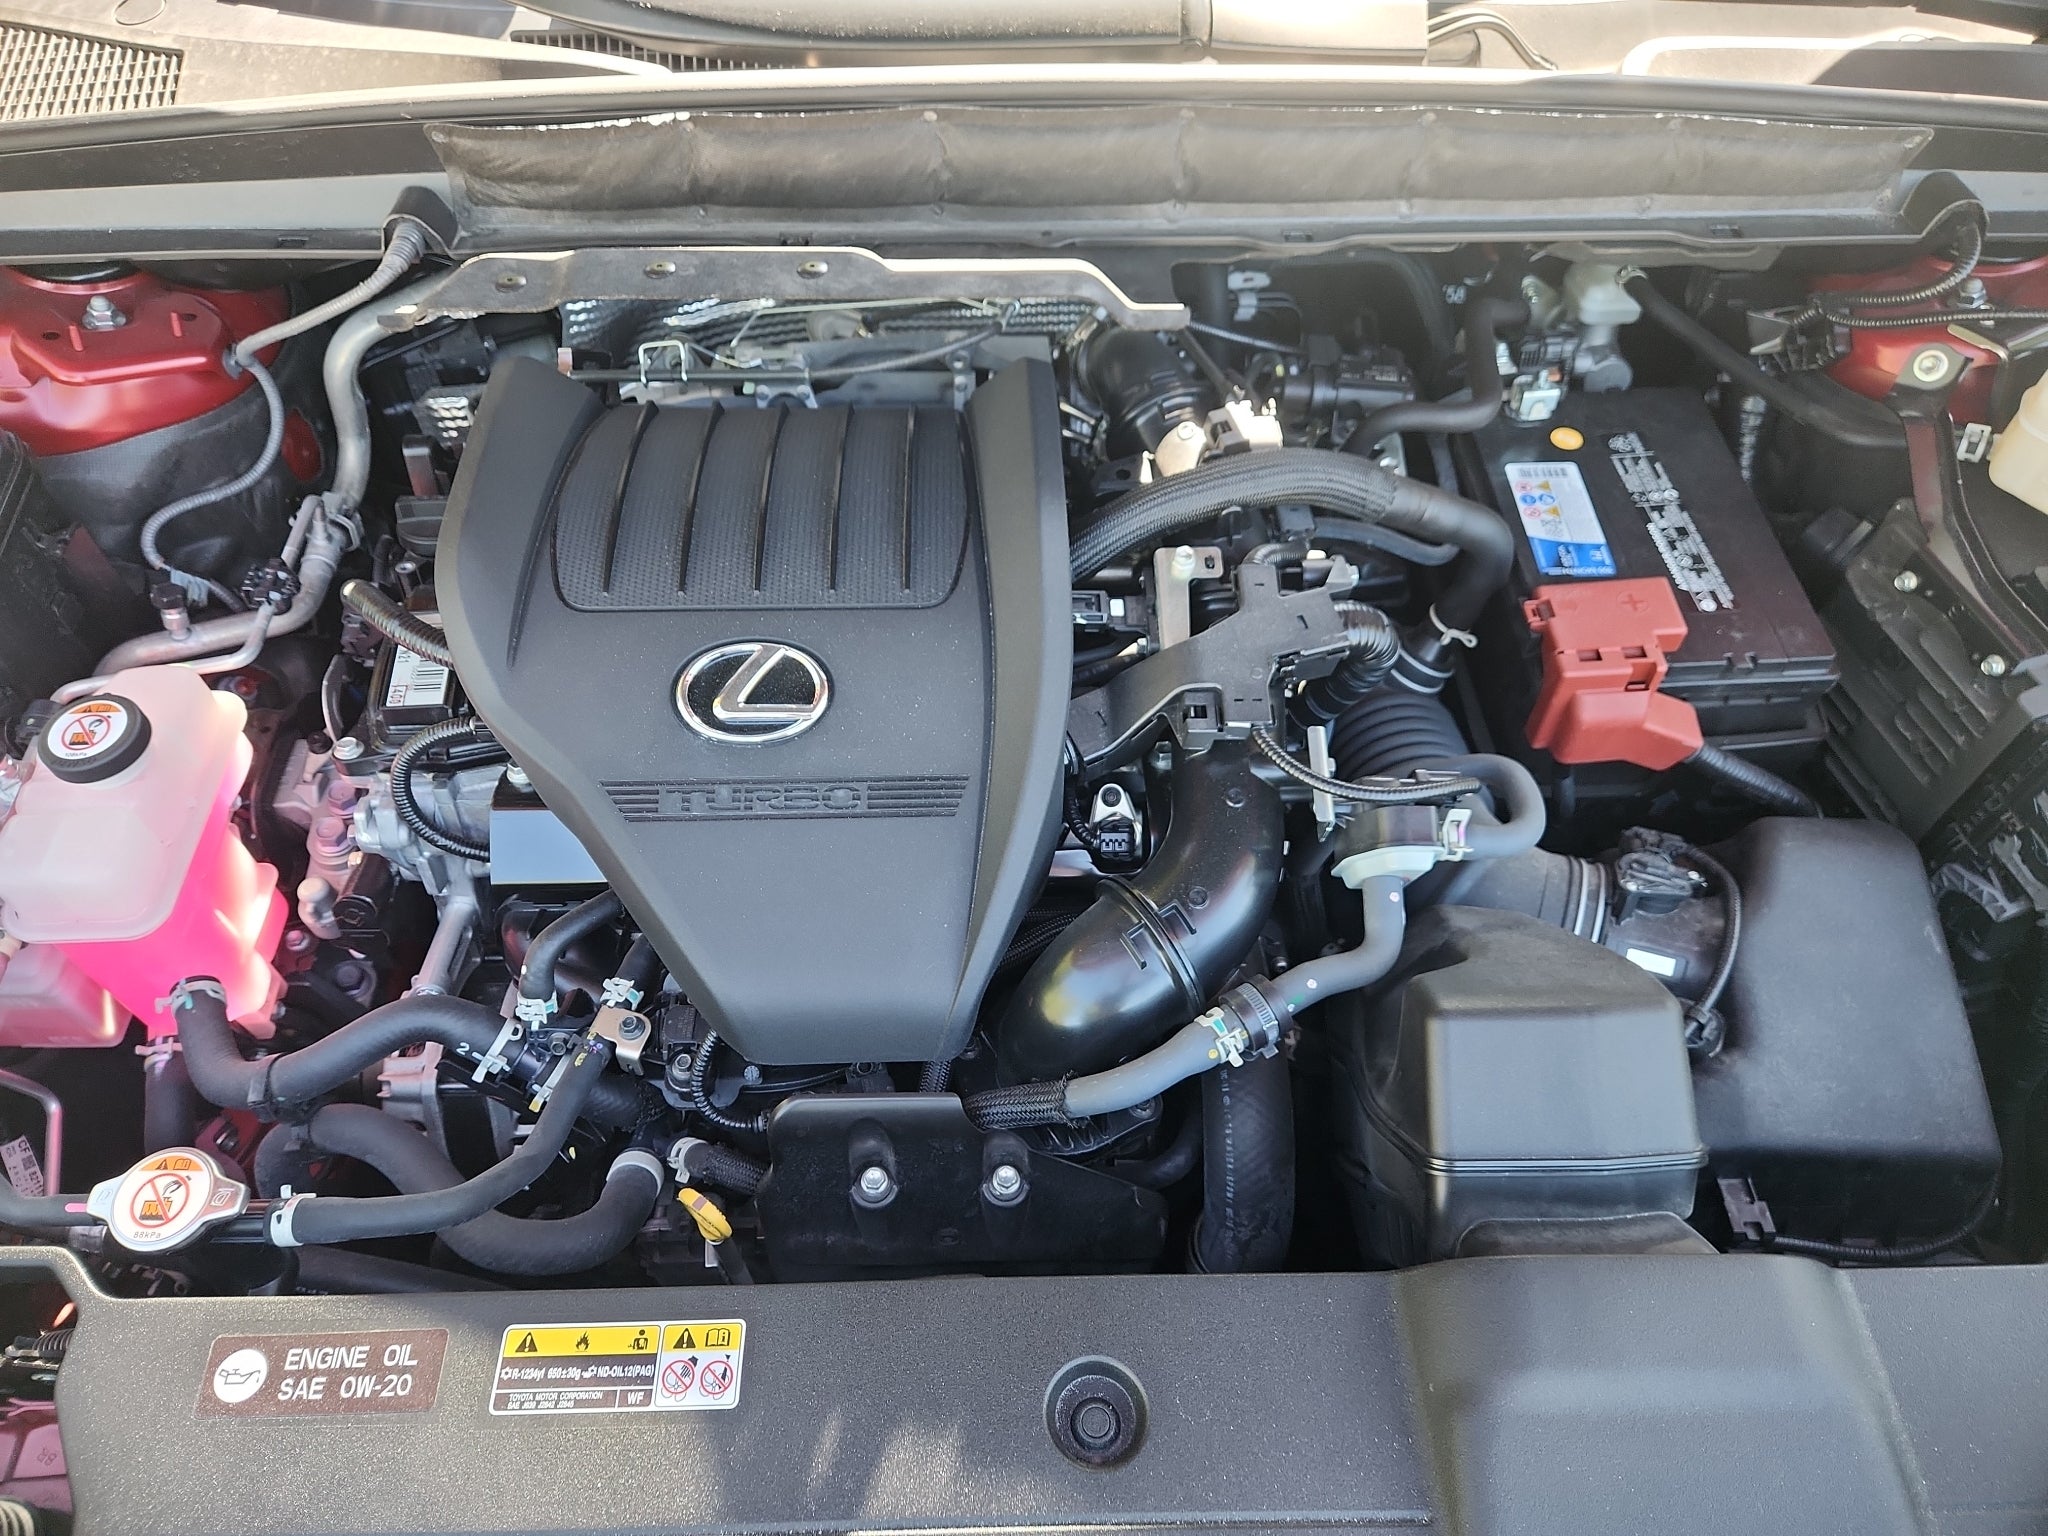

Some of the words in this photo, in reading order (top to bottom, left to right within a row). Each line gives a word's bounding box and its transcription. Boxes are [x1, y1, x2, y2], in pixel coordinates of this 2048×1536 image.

[665, 784, 861, 812] TURBO
[456, 1042, 470, 1055] 2
[133, 1231, 162, 1239] 88kPa
[284, 1345, 371, 1370] ENGINE
[383, 1343, 419, 1367] OIL
[277, 1376, 328, 1401] SAE
[509, 1393, 534, 1401] TOYOTA
[535, 1392, 558, 1400] MOTOR
[559, 1391, 603, 1400] CORPORATION
[627, 1391, 645, 1405] WF
